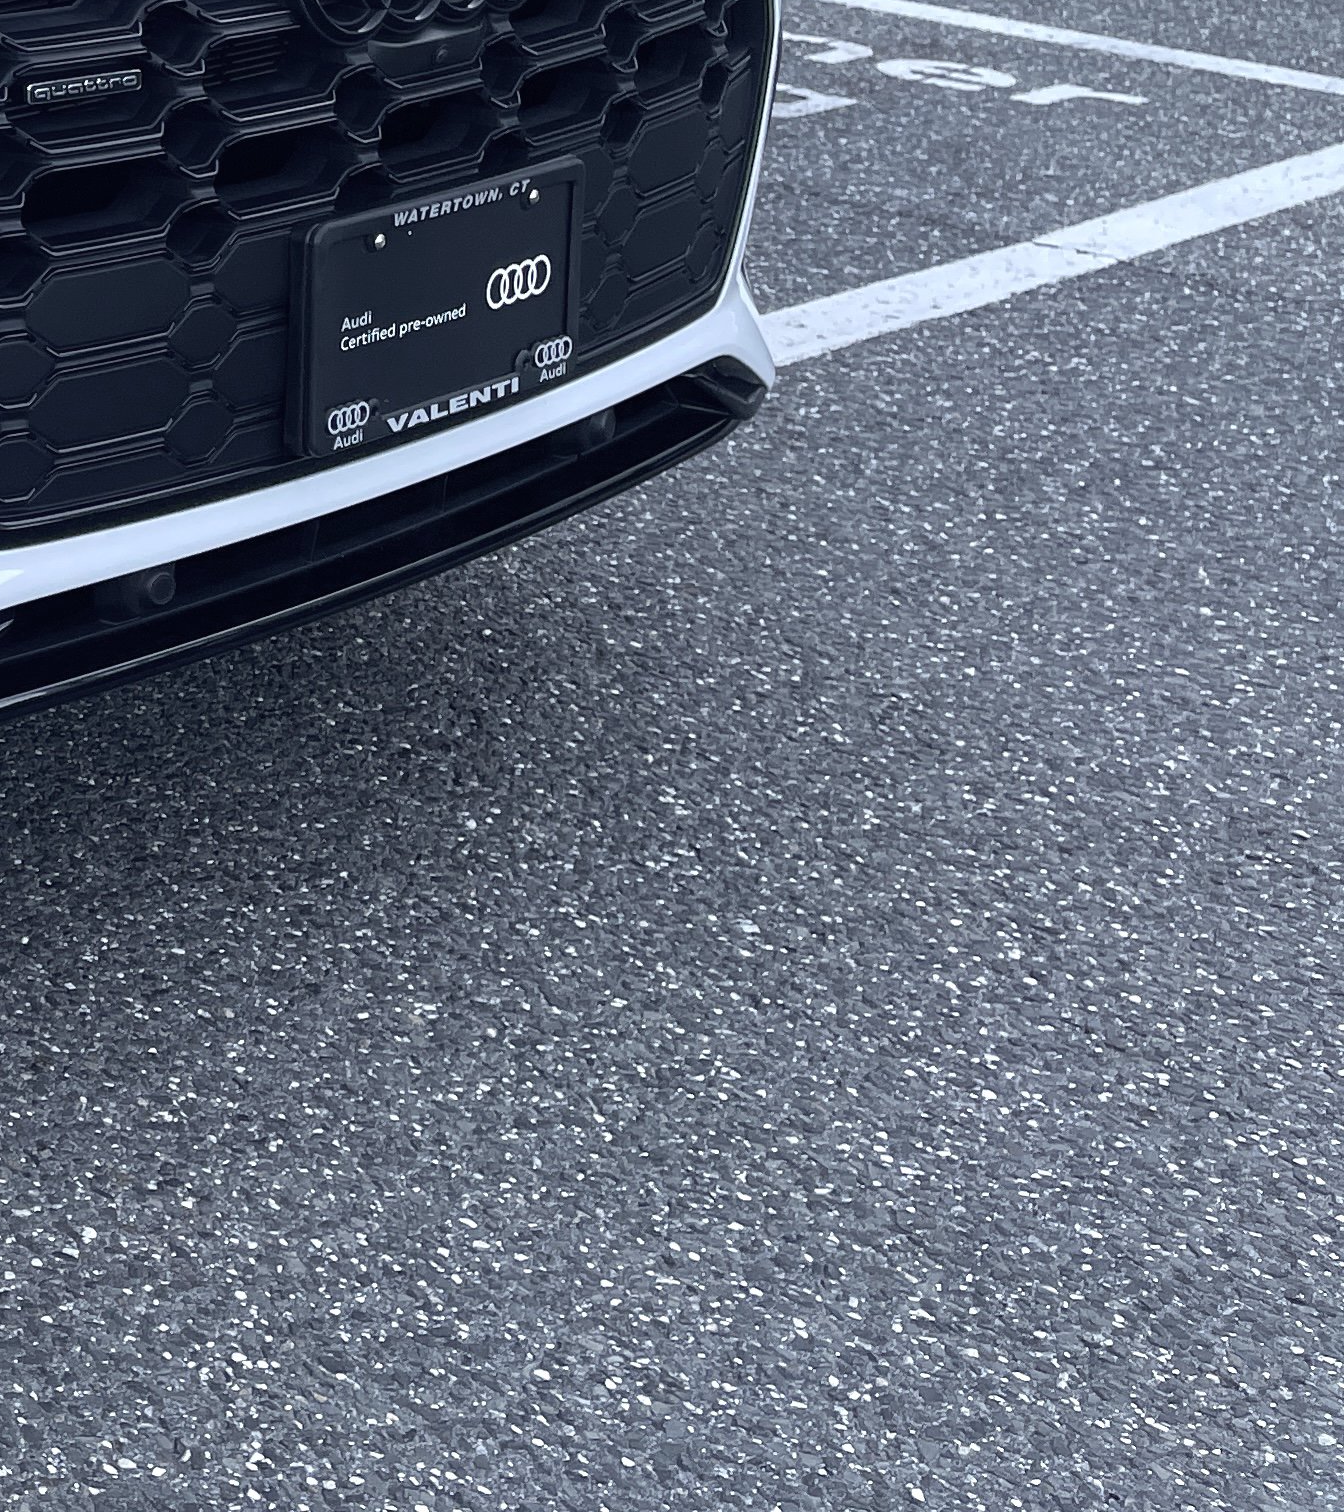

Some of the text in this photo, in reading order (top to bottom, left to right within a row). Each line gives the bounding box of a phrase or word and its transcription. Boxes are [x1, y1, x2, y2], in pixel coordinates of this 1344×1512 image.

[33, 75, 138, 101] quattro
[393, 179, 531, 227] WATERTOWN, CT
[340, 310, 372, 332] Audi
[340, 303, 467, 351] Certified pre-owned
[539, 362, 567, 383] Audi
[386, 377, 520, 433] VALENTI
[333, 429, 364, 451] Audi
